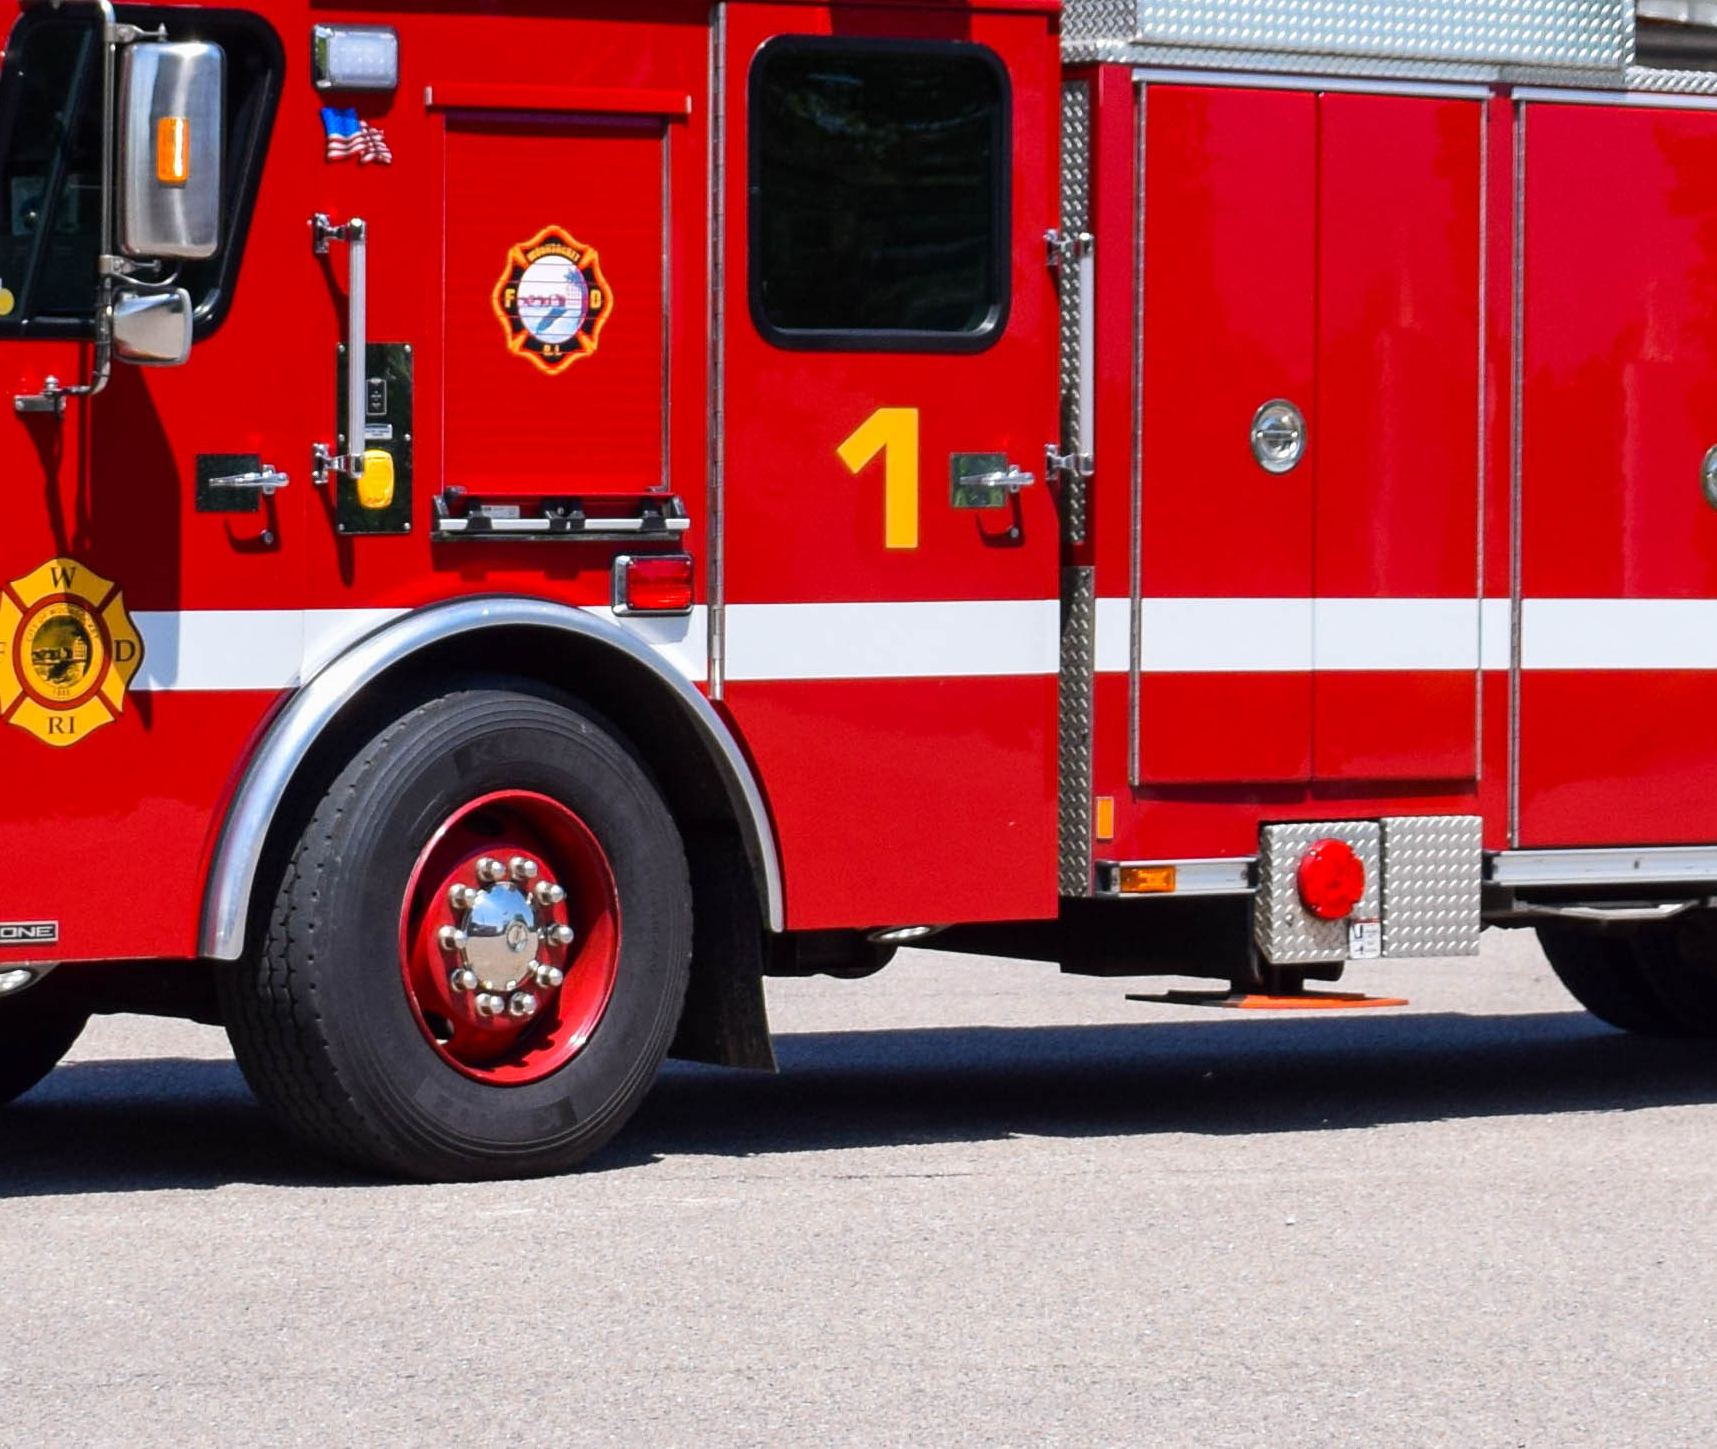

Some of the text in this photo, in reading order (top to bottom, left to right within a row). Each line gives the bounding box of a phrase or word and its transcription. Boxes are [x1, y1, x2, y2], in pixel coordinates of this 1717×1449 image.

[504, 288, 516, 308] F
[590, 289, 602, 309] D
[837, 408, 918, 548] 1
[50, 567, 76, 588] W
[114, 640, 136, 662] D
[48, 716, 75, 734] RI
